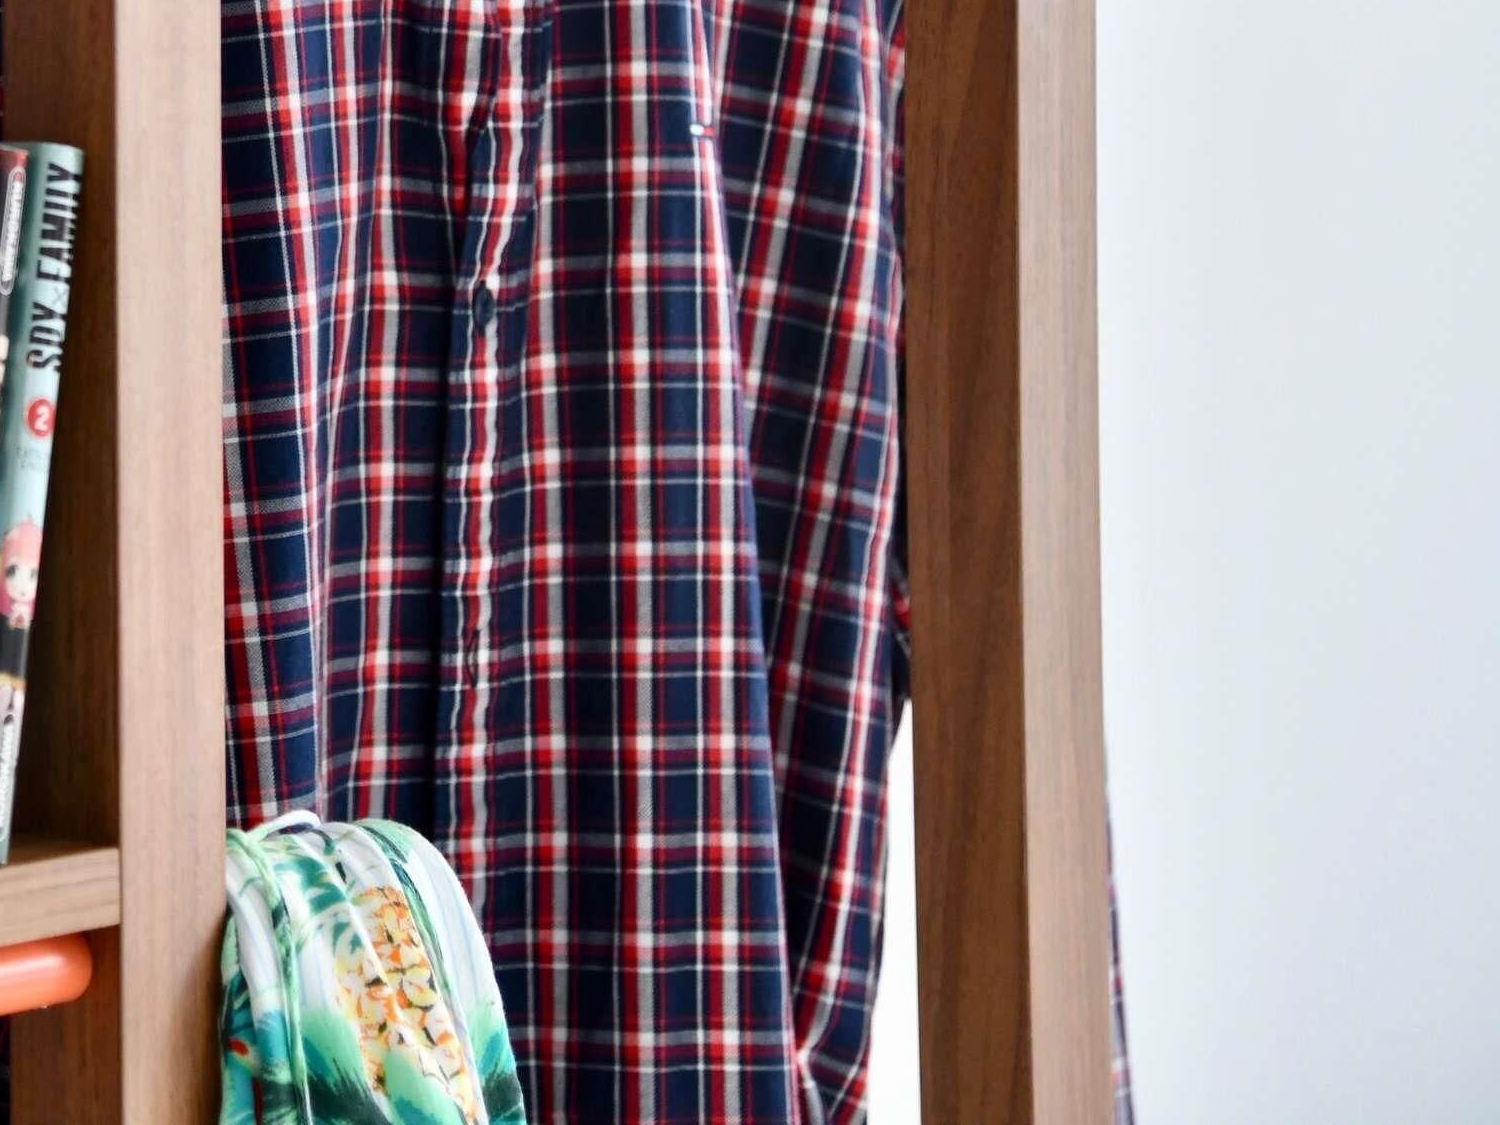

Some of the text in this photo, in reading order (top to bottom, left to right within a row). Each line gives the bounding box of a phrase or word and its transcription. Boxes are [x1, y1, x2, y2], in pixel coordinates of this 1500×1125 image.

[36, 162, 82, 285] FAMILY
[27, 301, 70, 374] SPY
[33, 406, 51, 432] 2
